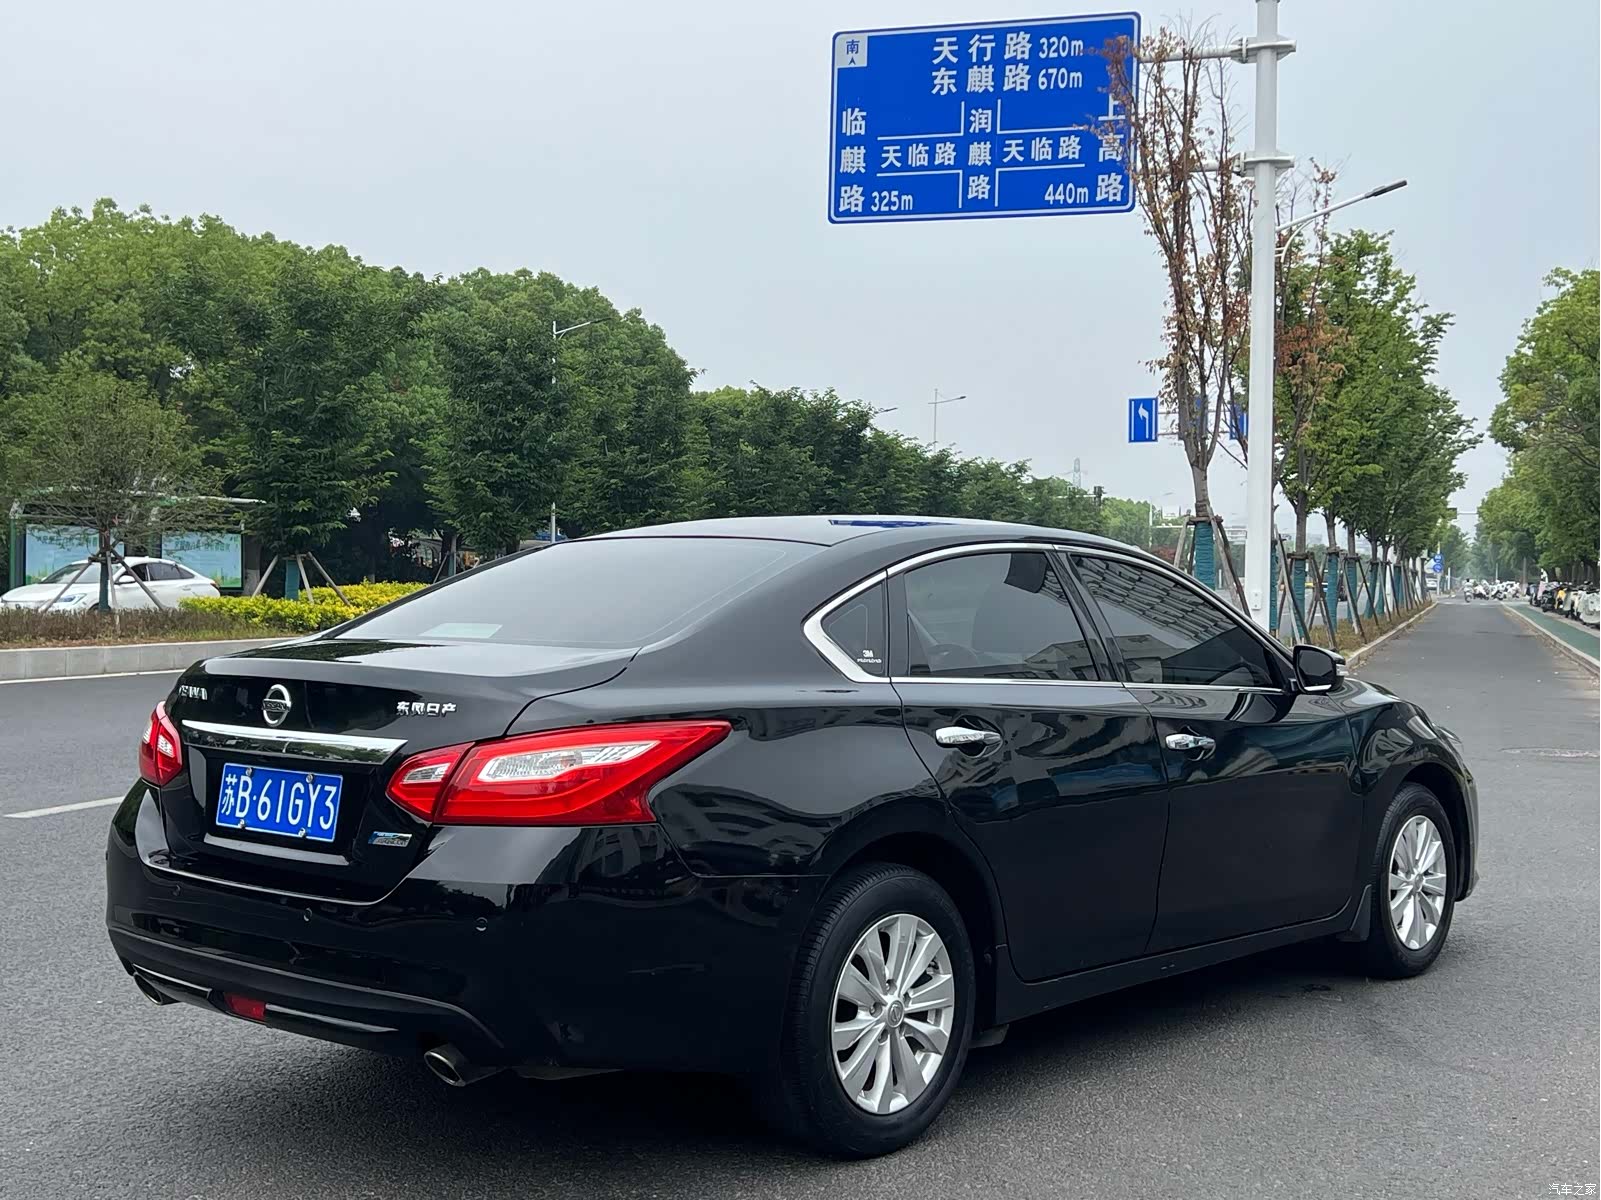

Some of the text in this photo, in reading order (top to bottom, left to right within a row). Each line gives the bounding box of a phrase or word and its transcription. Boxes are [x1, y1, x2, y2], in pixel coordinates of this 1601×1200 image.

[845, 39, 860, 55] 南
[932, 31, 1084, 64] 天行路 320m
[931, 63, 1083, 95] 东麒路 670m
[839, 107, 867, 213] 临麒路
[881, 142, 957, 169] 天临路
[967, 108, 992, 200] 润麒路
[1002, 135, 1082, 163] 天临路
[871, 190, 913, 212] 325m
[1044, 183, 1089, 205] 440m
[396, 701, 457, 716] 东风日产
